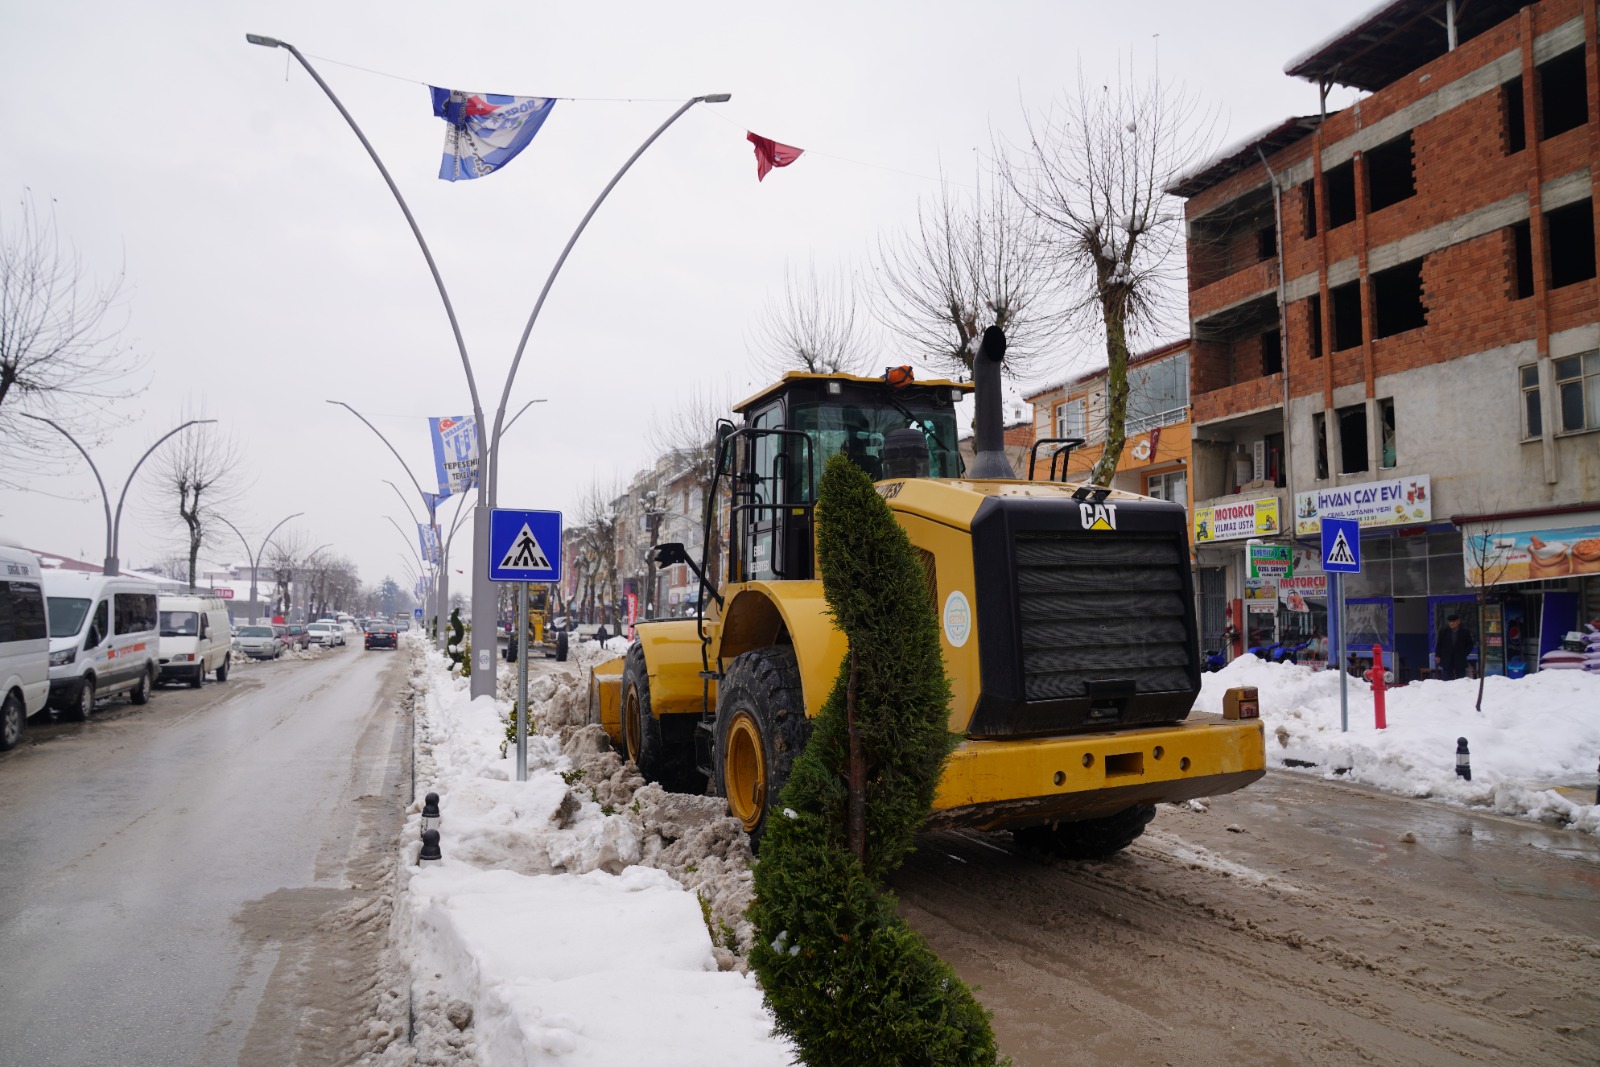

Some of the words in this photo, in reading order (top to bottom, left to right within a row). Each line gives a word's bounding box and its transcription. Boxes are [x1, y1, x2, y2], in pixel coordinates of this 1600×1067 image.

[1318, 490, 1352, 509] İHVAN
[1381, 480, 1402, 501] EVİ
[1079, 503, 1117, 530] CAT
[1214, 503, 1255, 521] MOTORCU
[1346, 507, 1374, 516] USTANIN
[1376, 505, 1392, 513] YERİ
[1214, 522, 1237, 533] YILMAZ
[1238, 520, 1254, 530] USTA
